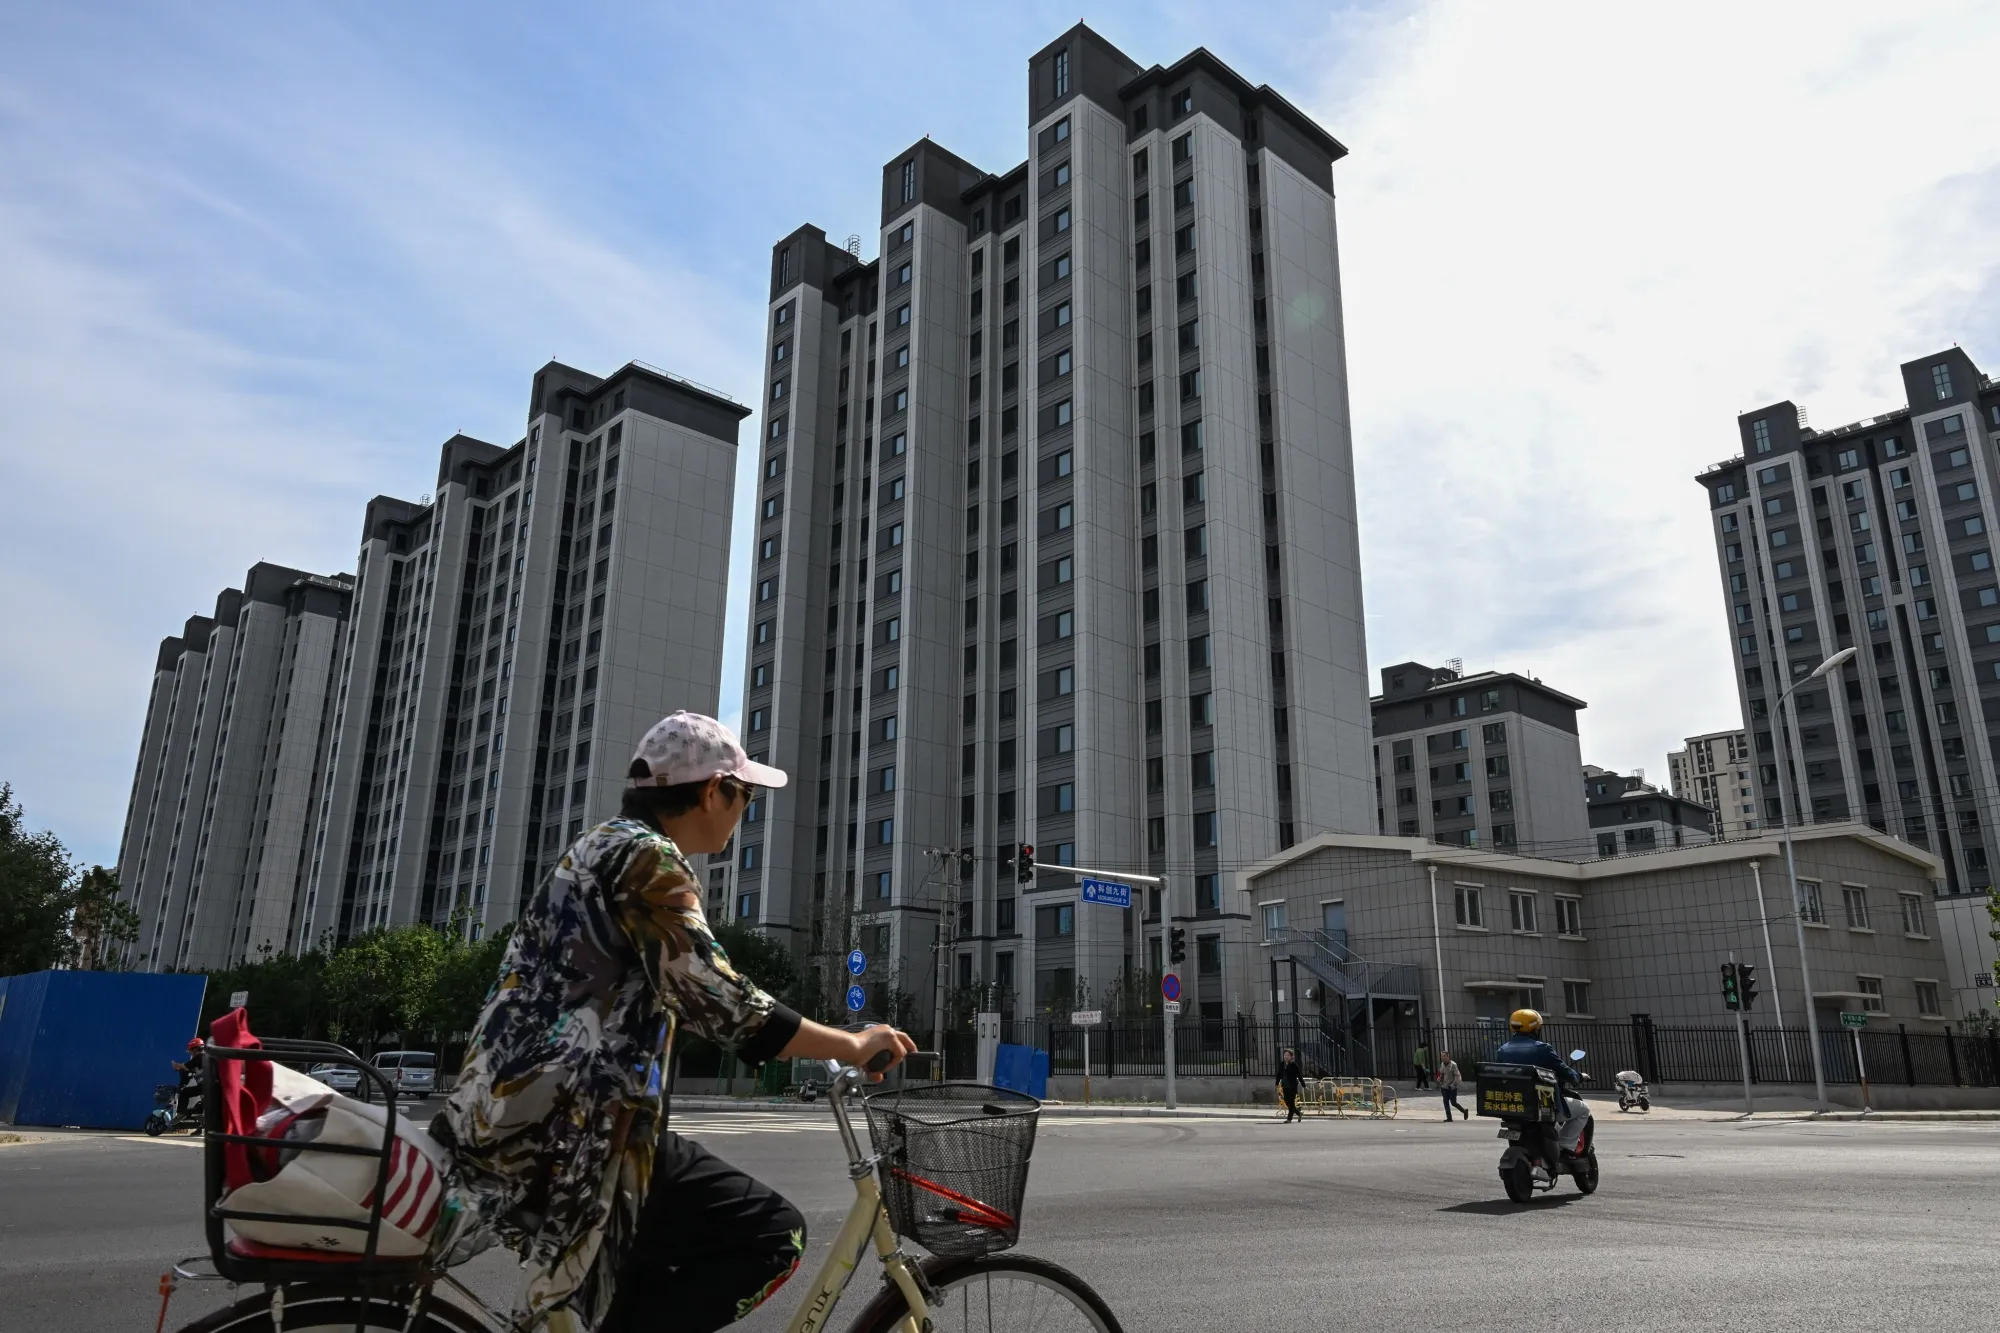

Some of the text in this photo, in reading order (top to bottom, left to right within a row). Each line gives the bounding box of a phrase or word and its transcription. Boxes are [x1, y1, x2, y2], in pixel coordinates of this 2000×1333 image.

[1098, 884, 1127, 897] 科创九街
[1485, 1090, 1523, 1102] 美团外卖
